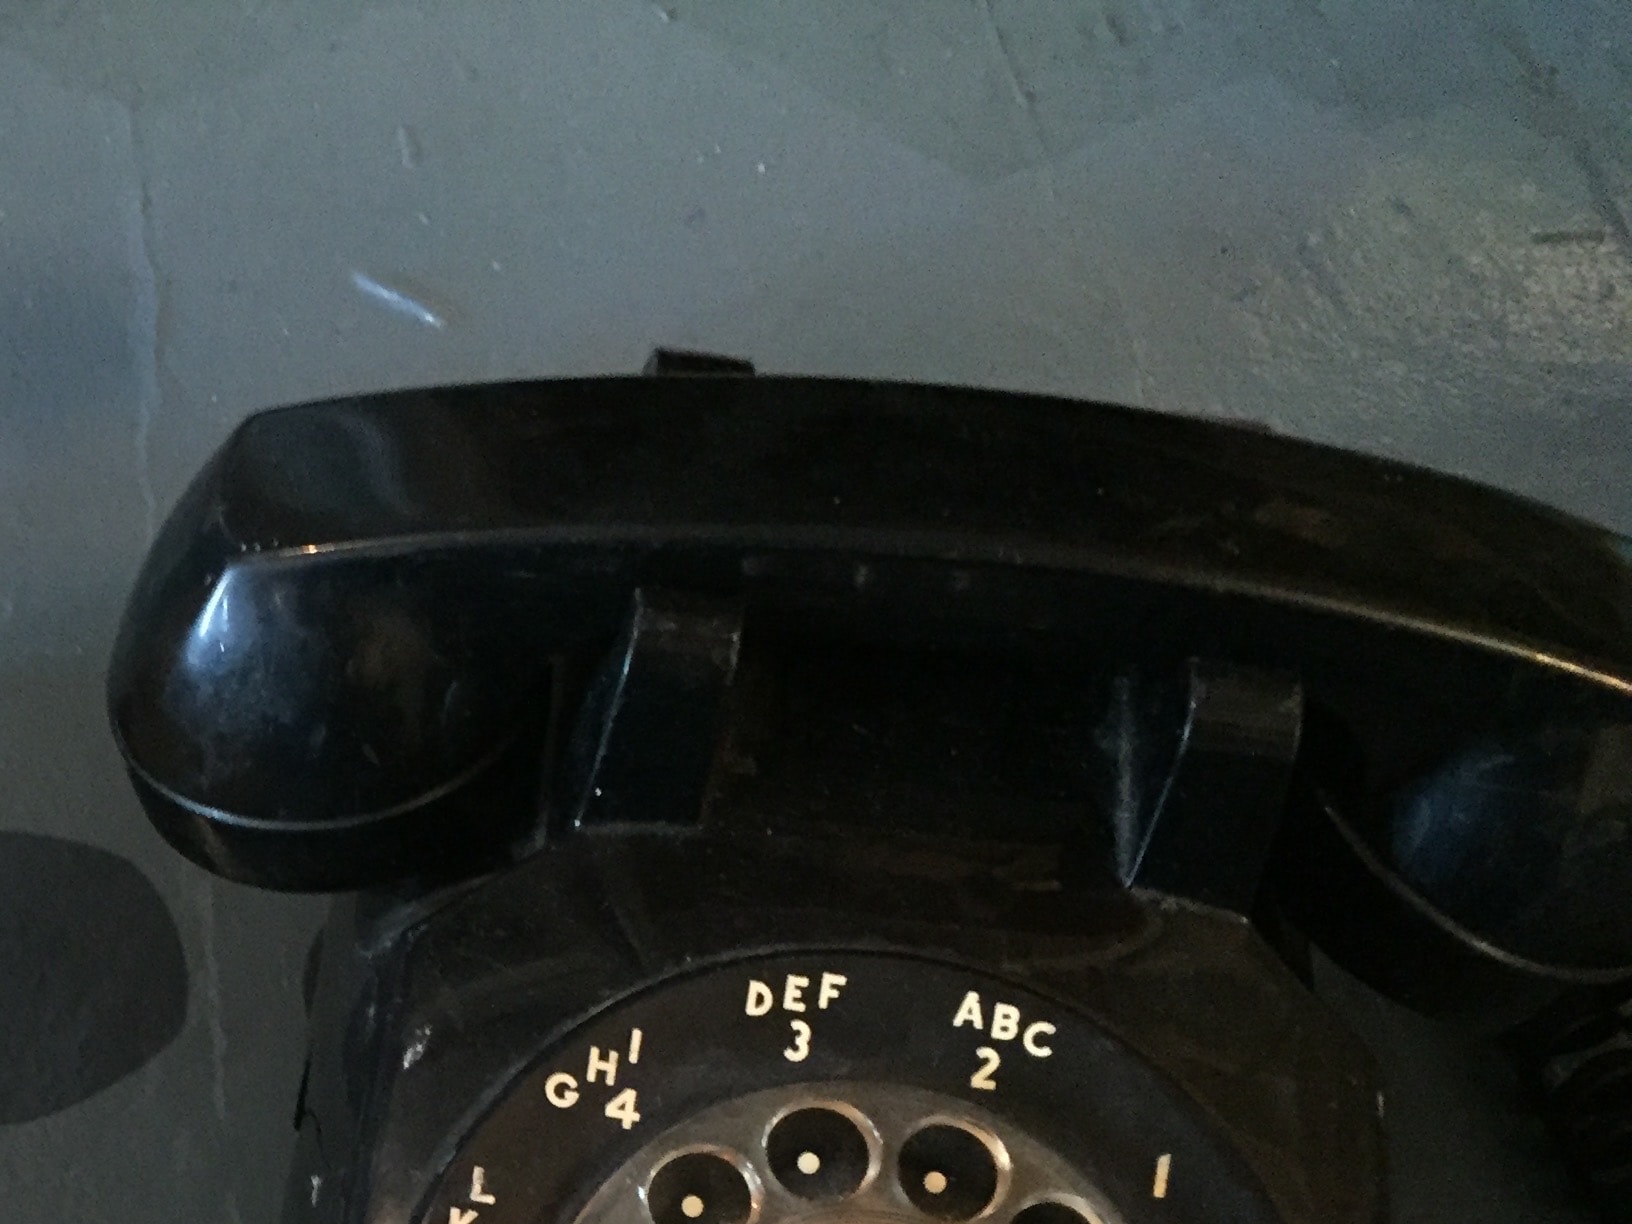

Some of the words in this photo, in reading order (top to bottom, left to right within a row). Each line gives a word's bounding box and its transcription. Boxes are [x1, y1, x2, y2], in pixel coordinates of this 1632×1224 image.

[745, 972, 847, 1017] DEF
[783, 1020, 812, 1062] 3
[953, 990, 1056, 1058] ABC
[970, 1046, 1000, 1090] 2
[604, 1088, 640, 1129] 4
